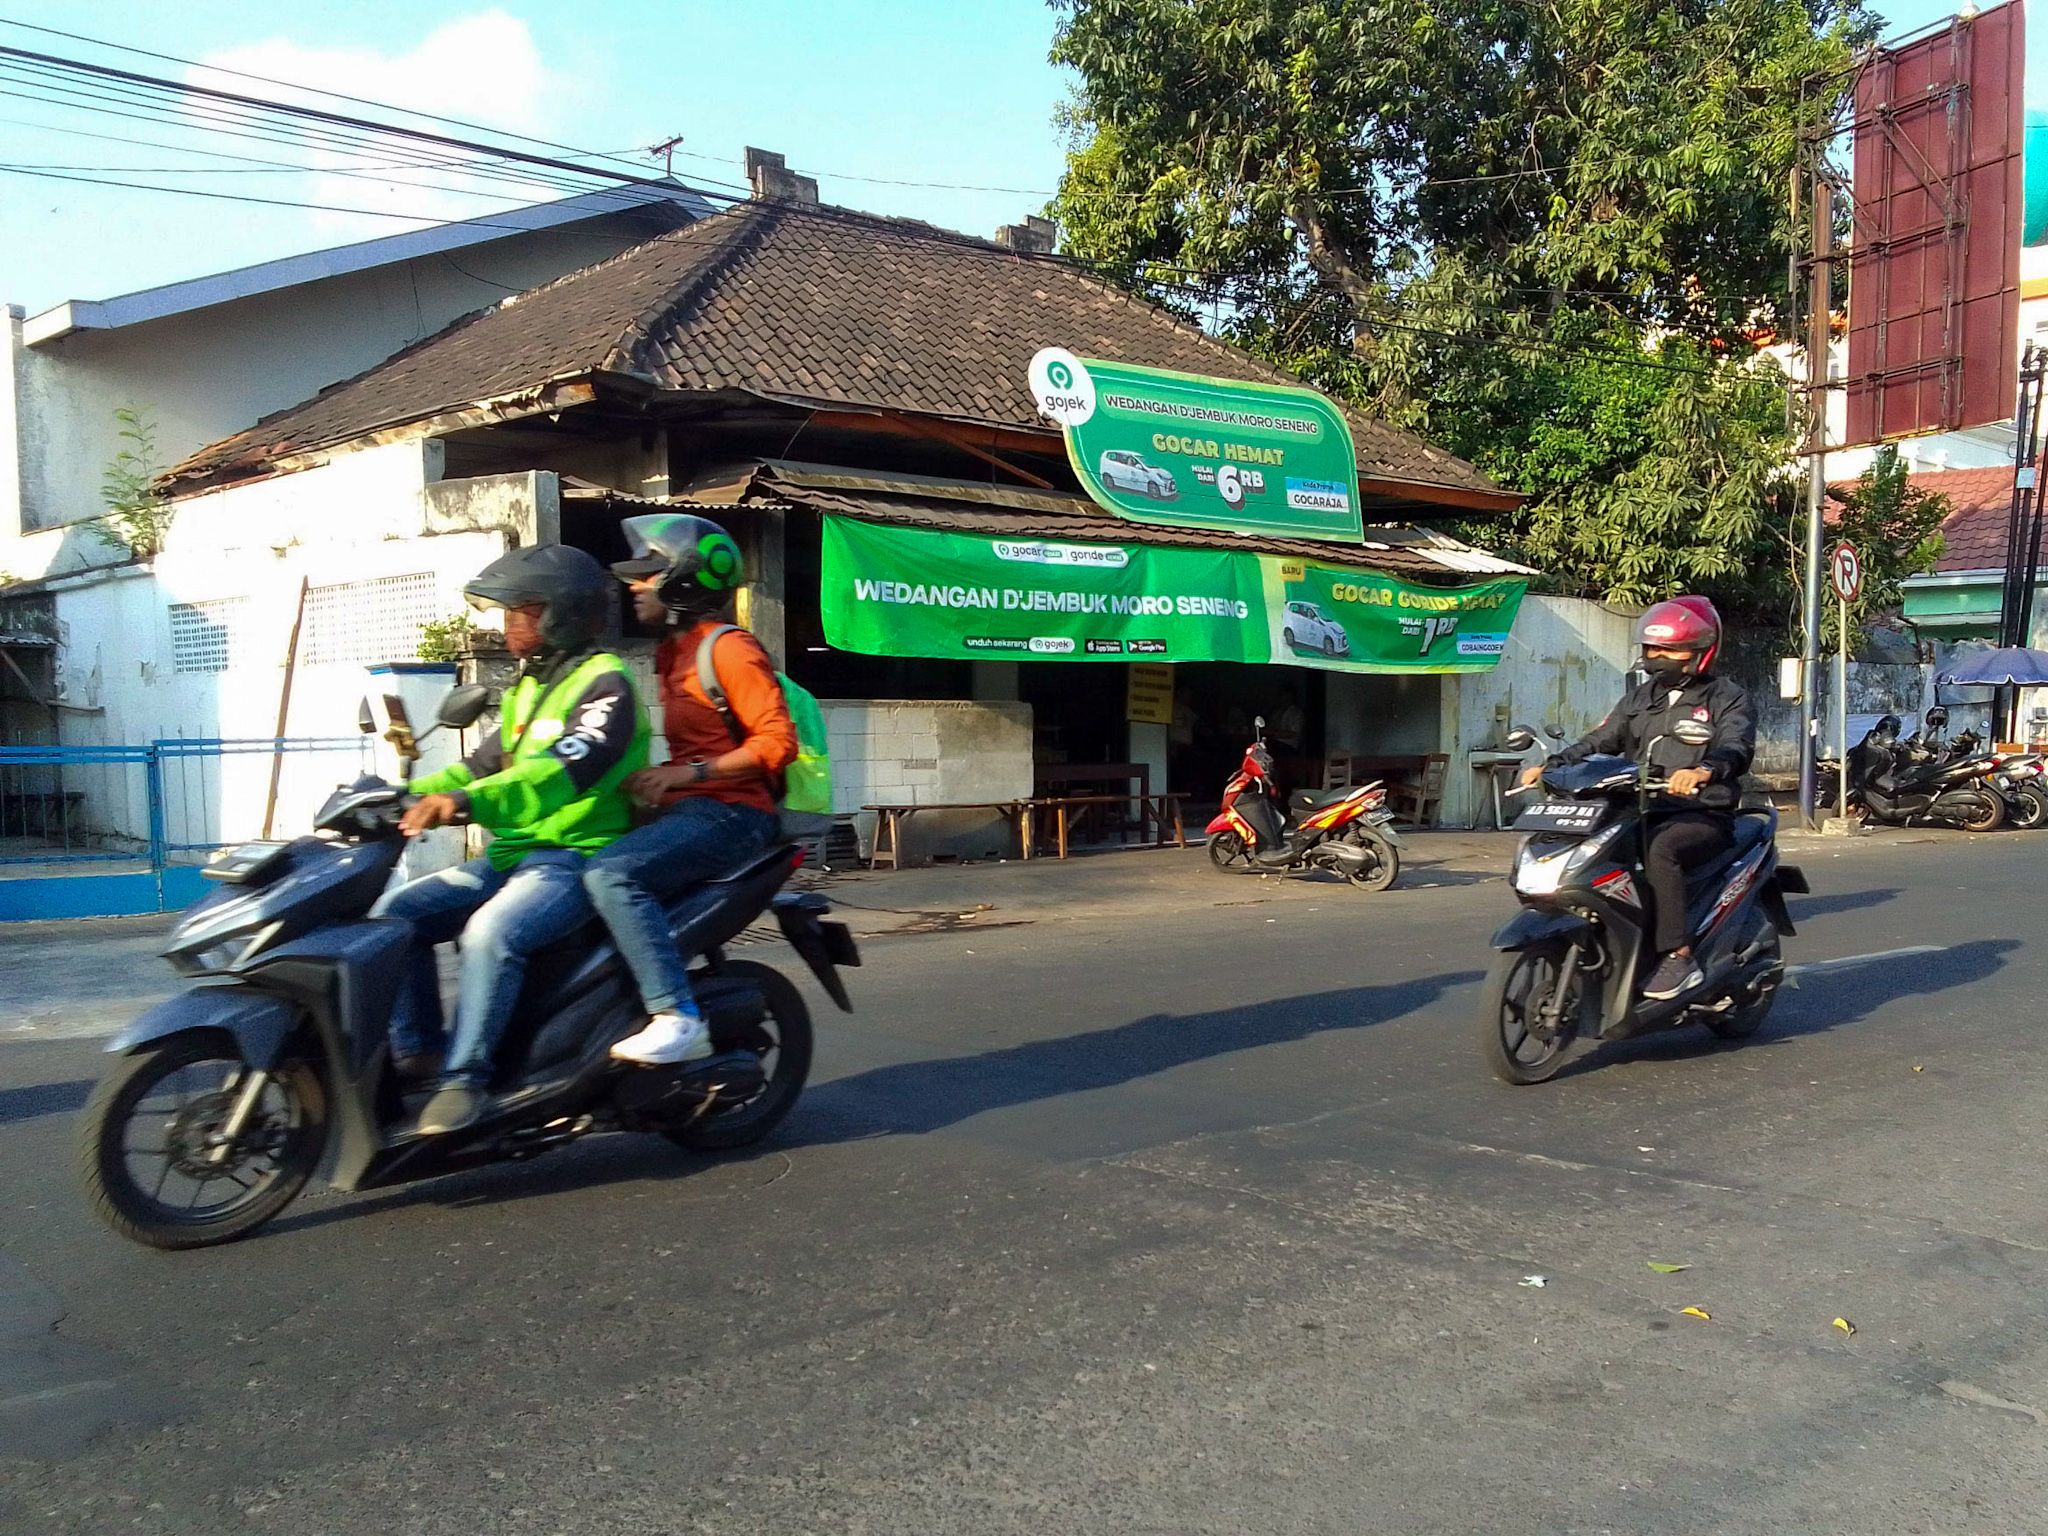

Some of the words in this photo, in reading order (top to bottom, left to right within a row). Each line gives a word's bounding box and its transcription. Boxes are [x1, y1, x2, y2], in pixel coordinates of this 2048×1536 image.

[1045, 396, 1087, 412] gojek
[1105, 395, 1178, 416] WEDANGAN
[1180, 405, 1236, 424] D'JEMBUK
[1238, 414, 1273, 428] MORO
[1274, 420, 1318, 434] SENENG
[1152, 433, 1220, 459] GOCAR
[1223, 443, 1285, 467] HEMAT
[1217, 464, 1242, 504] 6
[1240, 470, 1265, 488] RB
[1294, 494, 1343, 509] GOCARAJA
[1012, 546, 1041, 557] gocar
[1070, 550, 1104, 561] goride
[1281, 566, 1302, 576] BARU
[854, 578, 998, 610] WEDANGAN
[1003, 588, 1108, 614] D'JEMBUK
[1111, 595, 1173, 615] MORO
[1176, 597, 1249, 620] SENENG
[1332, 583, 1393, 607] GOCAR
[1397, 591, 1459, 612] GORIDE
[967, 638, 993, 647] unduh
[993, 640, 1028, 650] sekarang
[1044, 639, 1069, 649] gojek
[1095, 645, 1106, 653] App
[1525, 806, 1545, 815] AD
